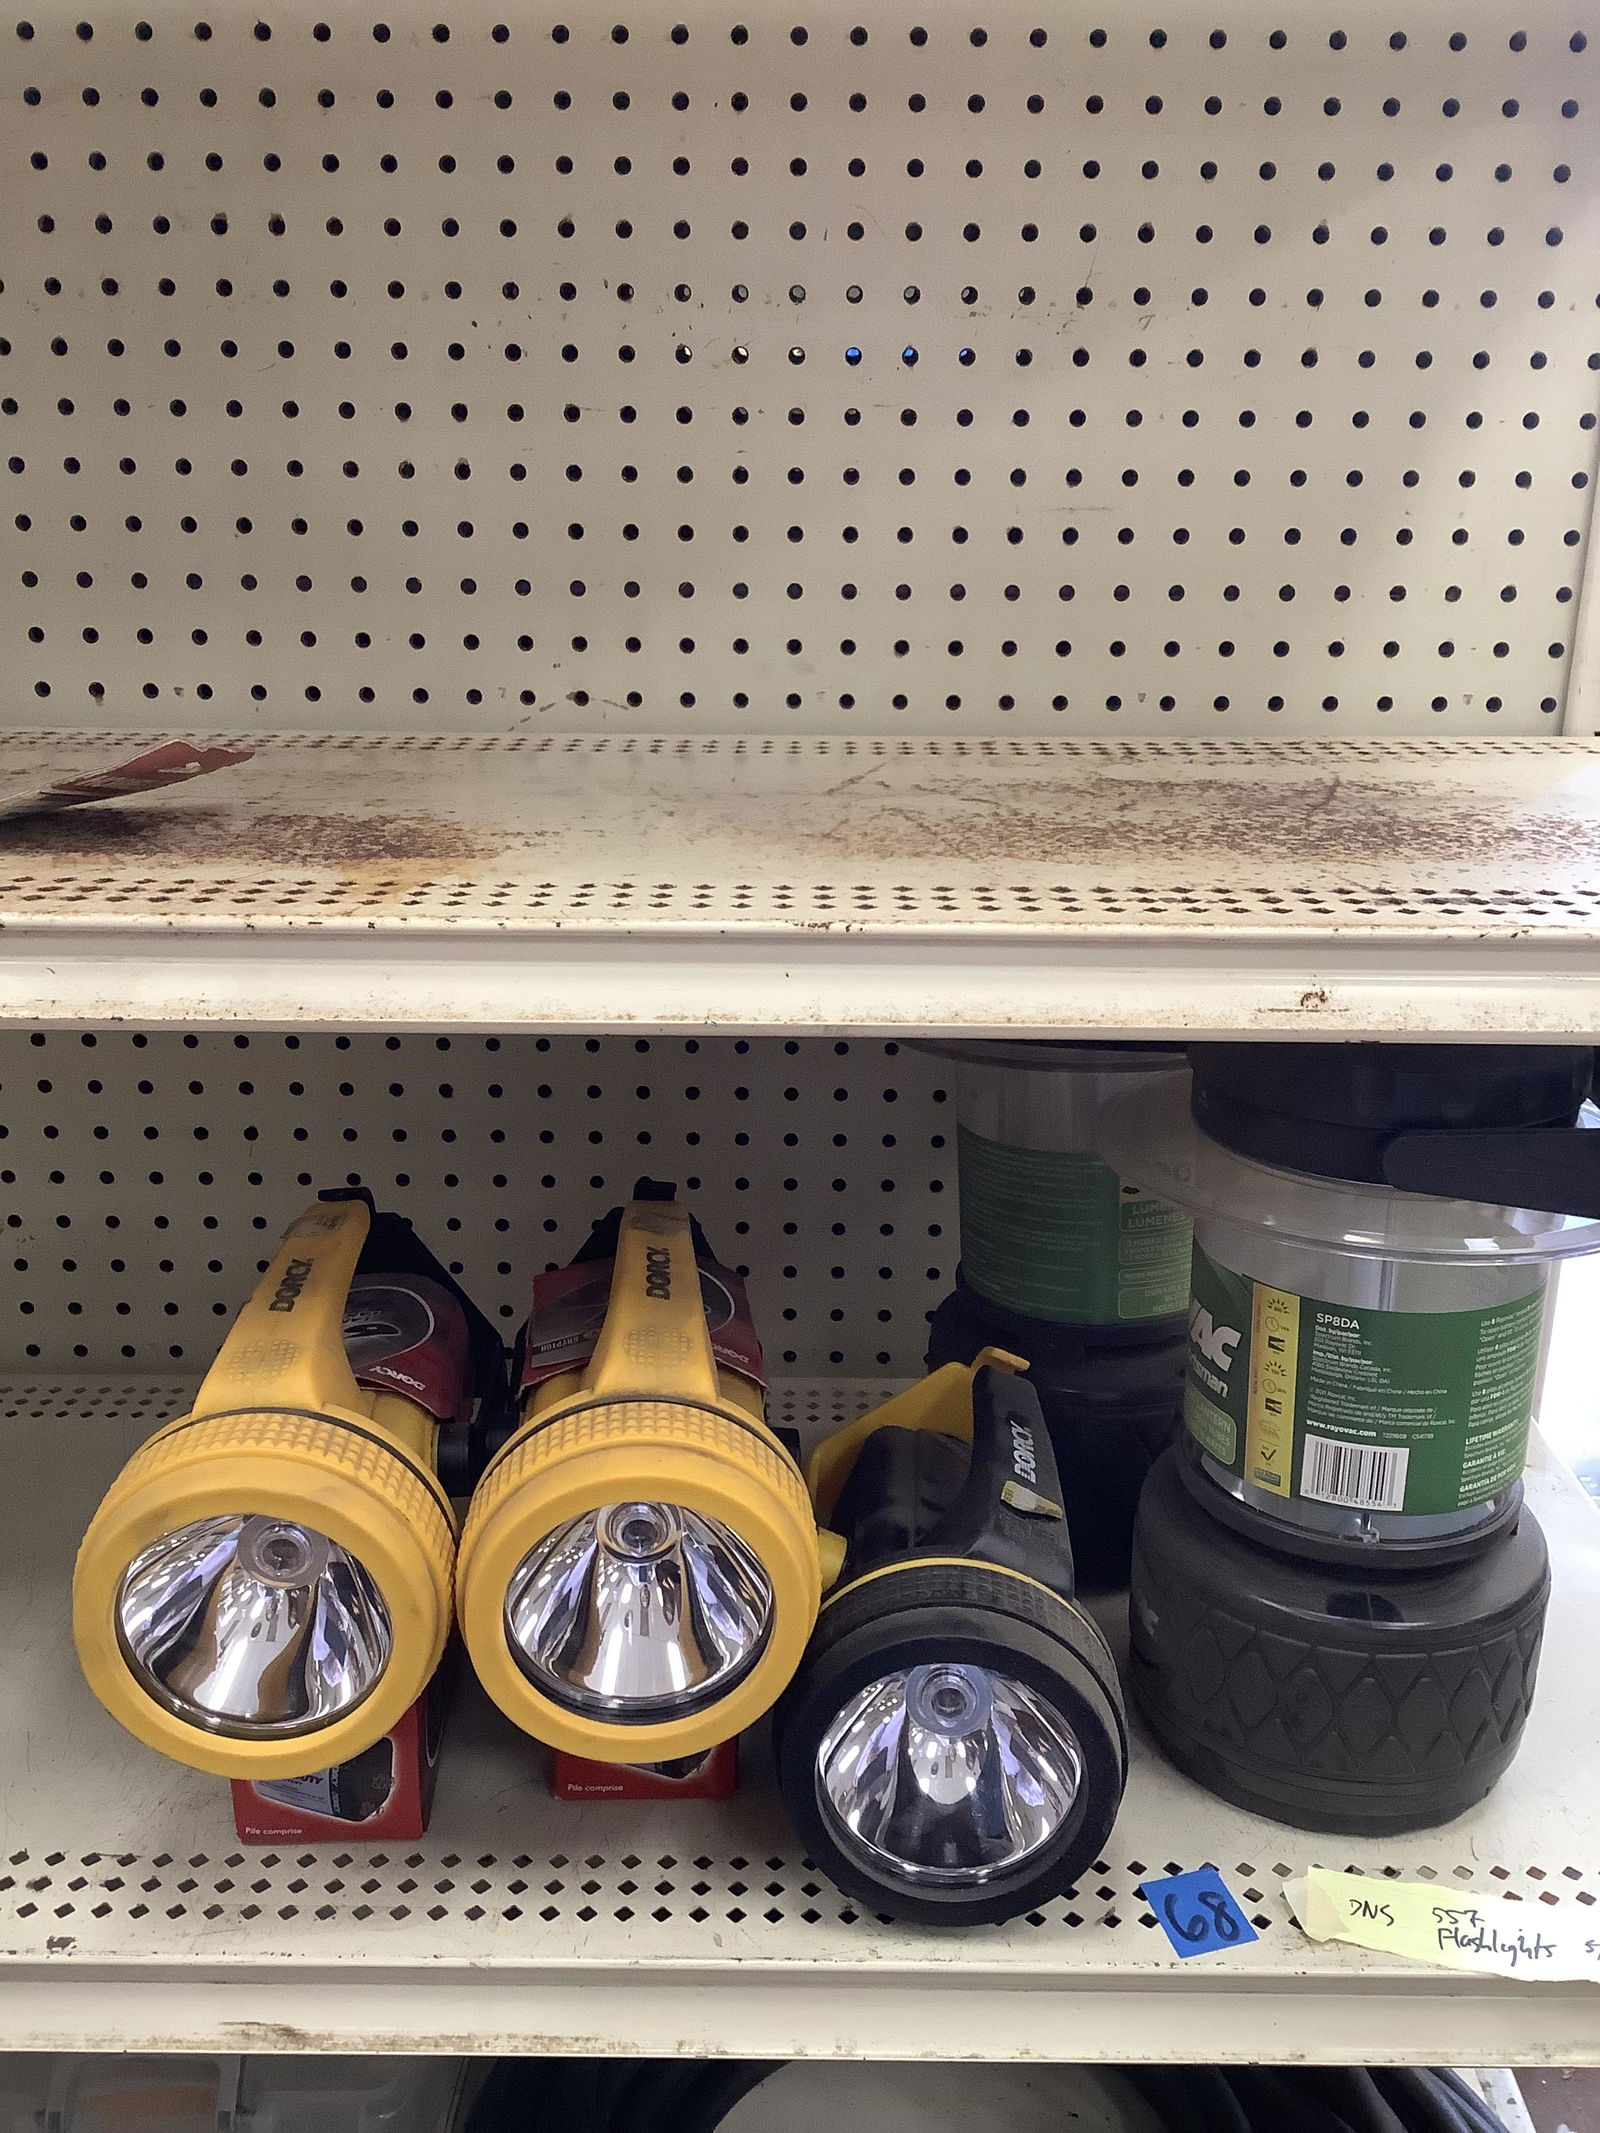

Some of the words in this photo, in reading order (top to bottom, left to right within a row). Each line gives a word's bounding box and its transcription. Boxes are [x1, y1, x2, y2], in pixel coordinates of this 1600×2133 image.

[269, 1258, 315, 1312] DORCY
[645, 1246, 671, 1301] DORCY
[1316, 1313, 1360, 1330] SP8DA
[368, 1365, 427, 1391] DORCY
[1306, 1419, 1377, 1438] www.rayovac.com
[1010, 1420, 1037, 1484] DORCY
[567, 1783, 583, 1792] Pile
[584, 1785, 624, 1793] comprise
[245, 1826, 261, 1835] Pile
[262, 1828, 303, 1836] comprise
[1164, 1891, 1242, 1943] 68
[1349, 1899, 1395, 1927] DNS
